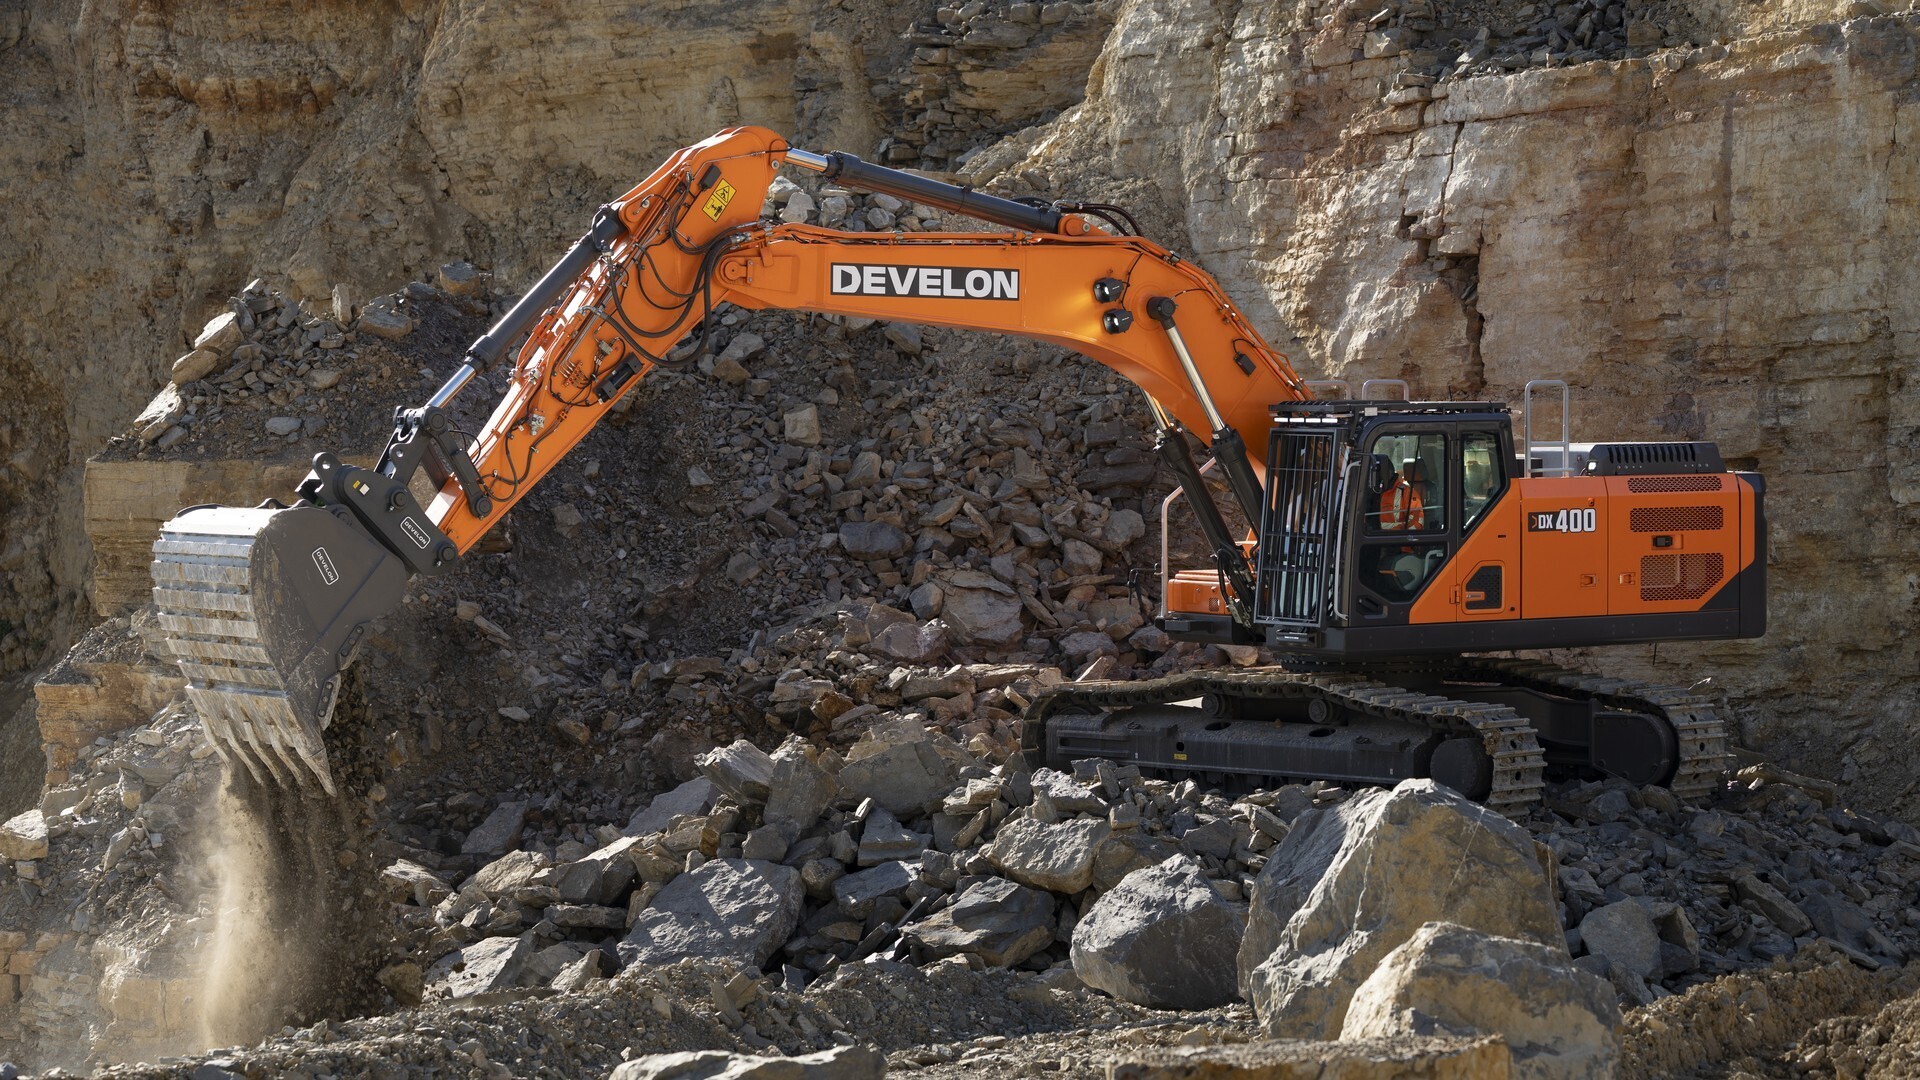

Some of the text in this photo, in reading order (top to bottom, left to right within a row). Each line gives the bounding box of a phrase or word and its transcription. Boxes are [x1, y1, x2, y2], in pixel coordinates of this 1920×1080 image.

[832, 265, 1018, 299] DEVELON
[404, 521, 427, 545] DEVELON
[316, 551, 335, 581] DEVELON
